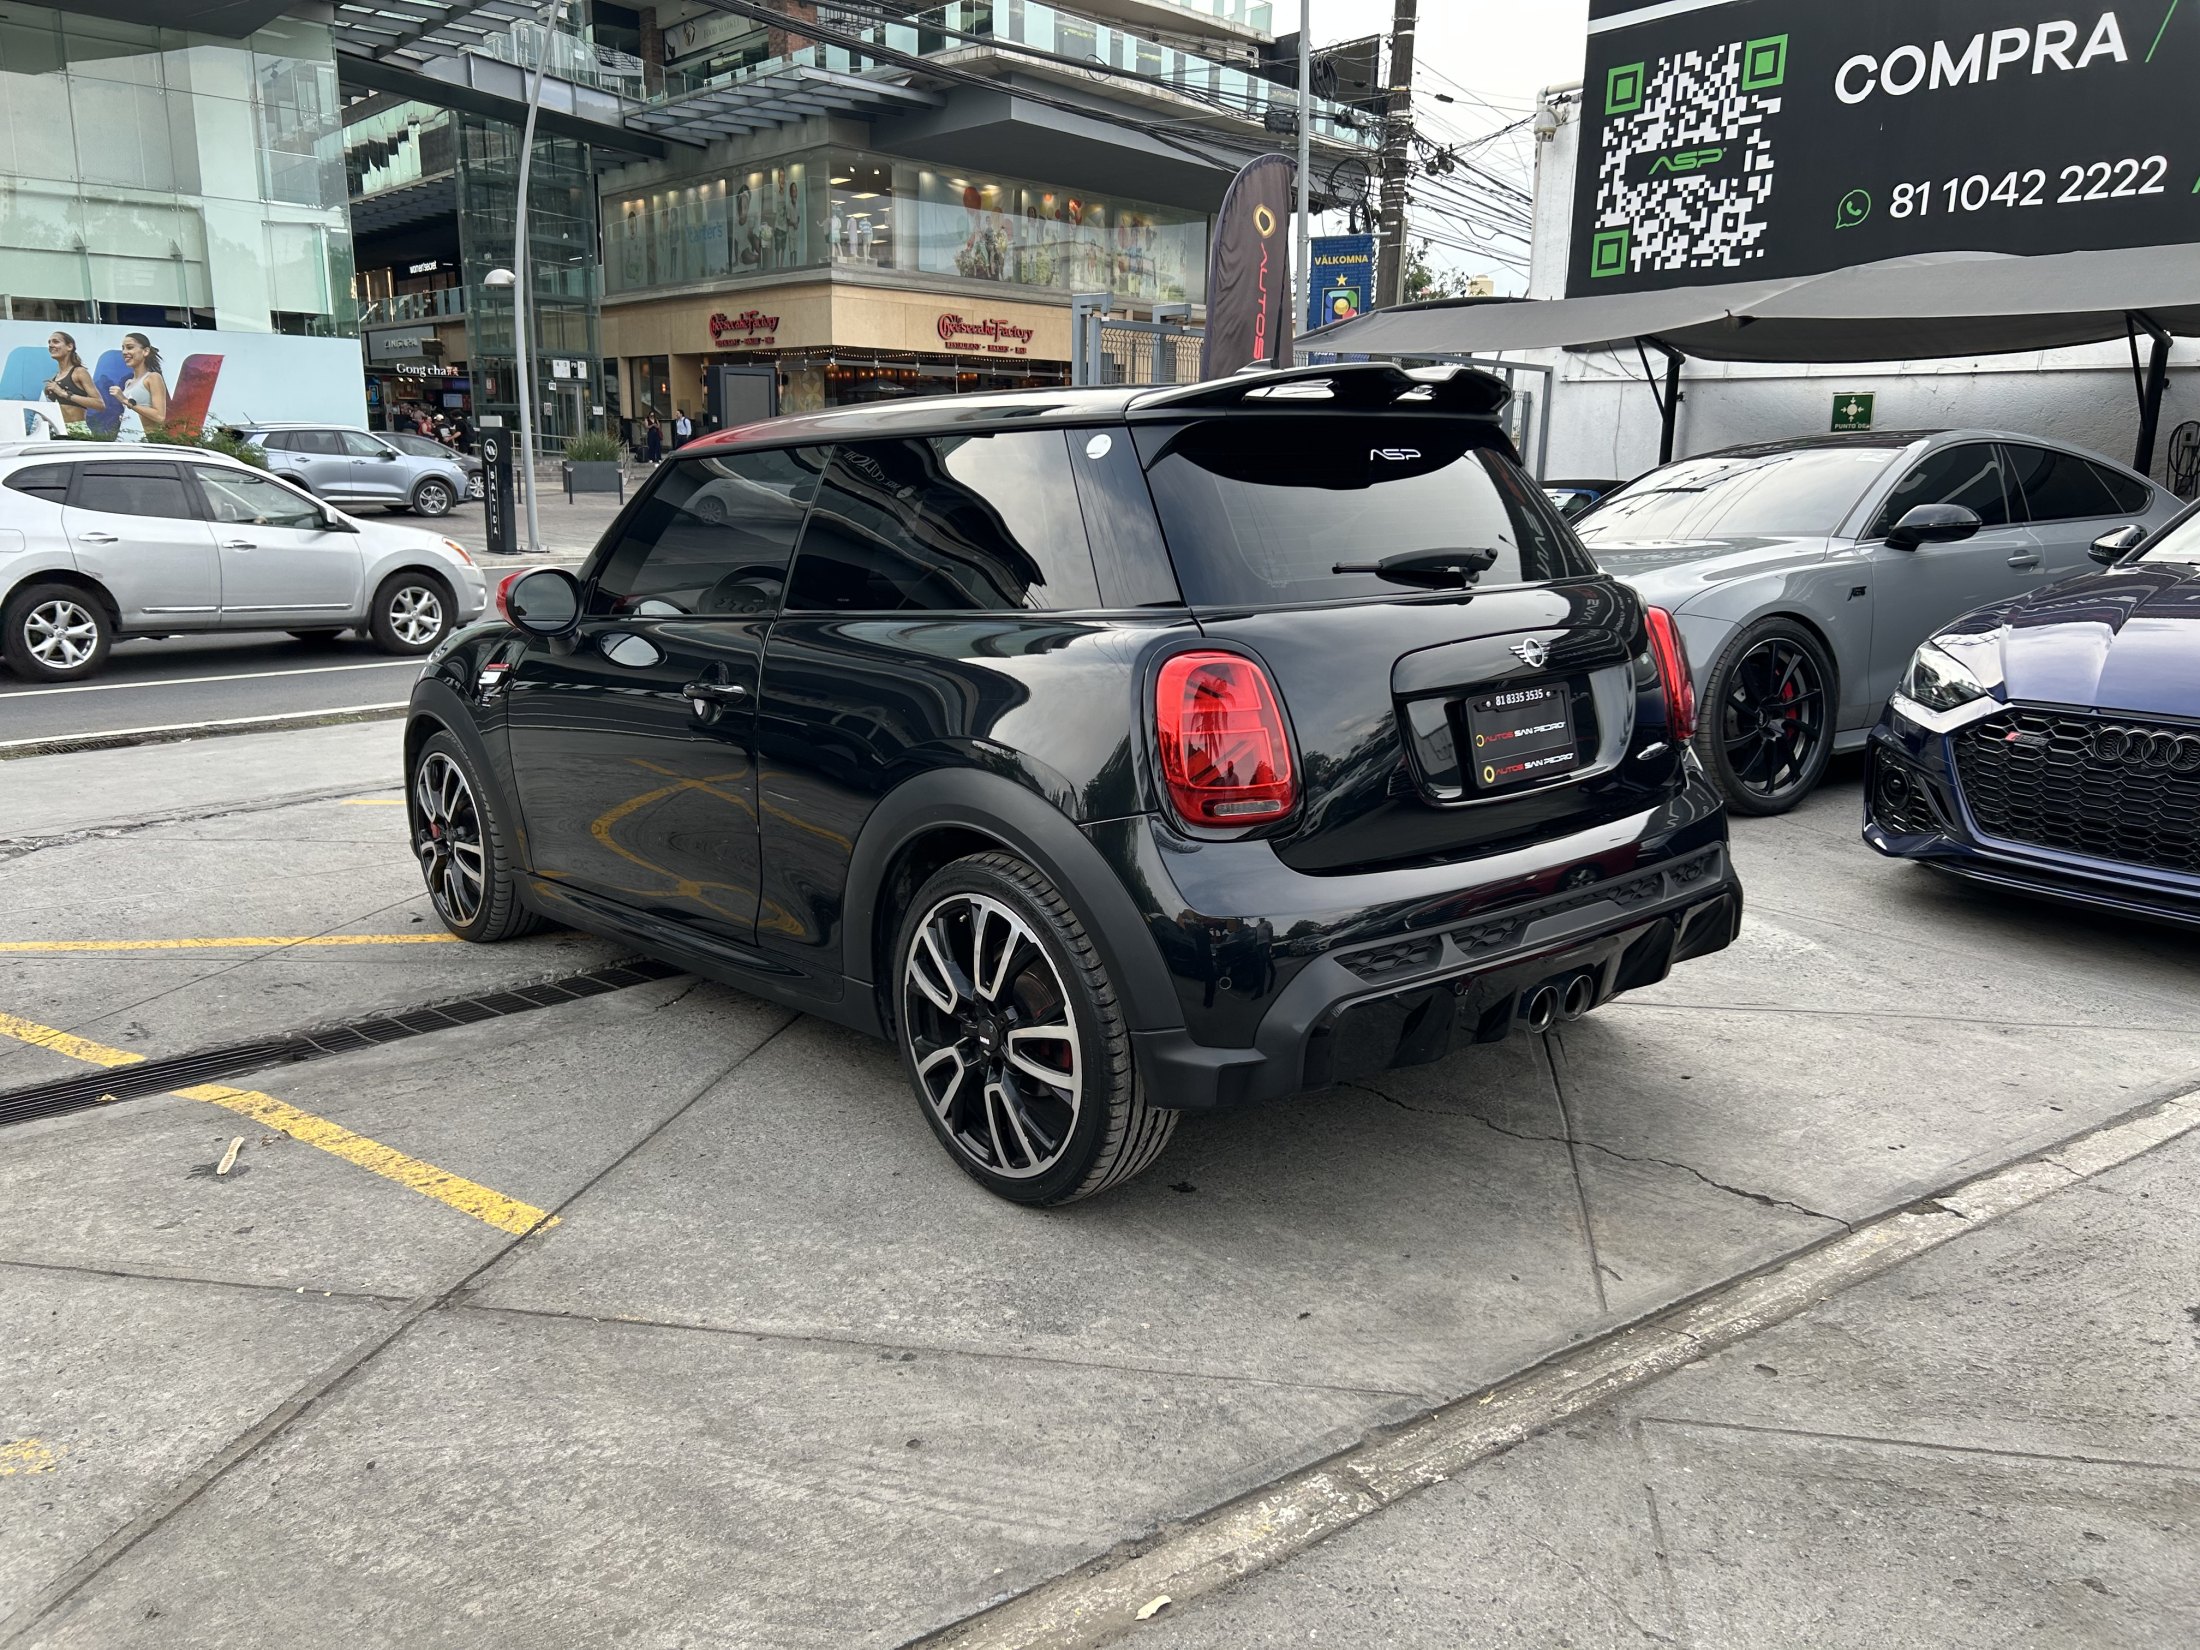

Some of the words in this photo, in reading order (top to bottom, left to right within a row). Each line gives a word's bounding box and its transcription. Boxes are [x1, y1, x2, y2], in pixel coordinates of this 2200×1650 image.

[1834, 12, 2129, 104] COMPRA
[1888, 181, 1929, 219] 81
[1944, 169, 2047, 213] 1042
[2056, 154, 2168, 204] 2222
[1314, 254, 1369, 266] VÄLKOMNA
[937, 313, 995, 340] Cheesecake
[990, 318, 1034, 344] Factory
[396, 363, 427, 378] Gong
[427, 365, 447, 376] cha
[489, 470, 499, 535] SALIDA
[1495, 694, 1506, 706] 81
[1506, 692, 1525, 704] 8335
[1525, 688, 1544, 700] 3535
[1484, 731, 1514, 743] AUTOS
[1514, 727, 1534, 737] SAN
[1534, 721, 1566, 733] PEDRO
[1495, 763, 1524, 775] AUTOS
[1524, 758, 1543, 770] SAN
[1543, 752, 1575, 765] PEDRO
